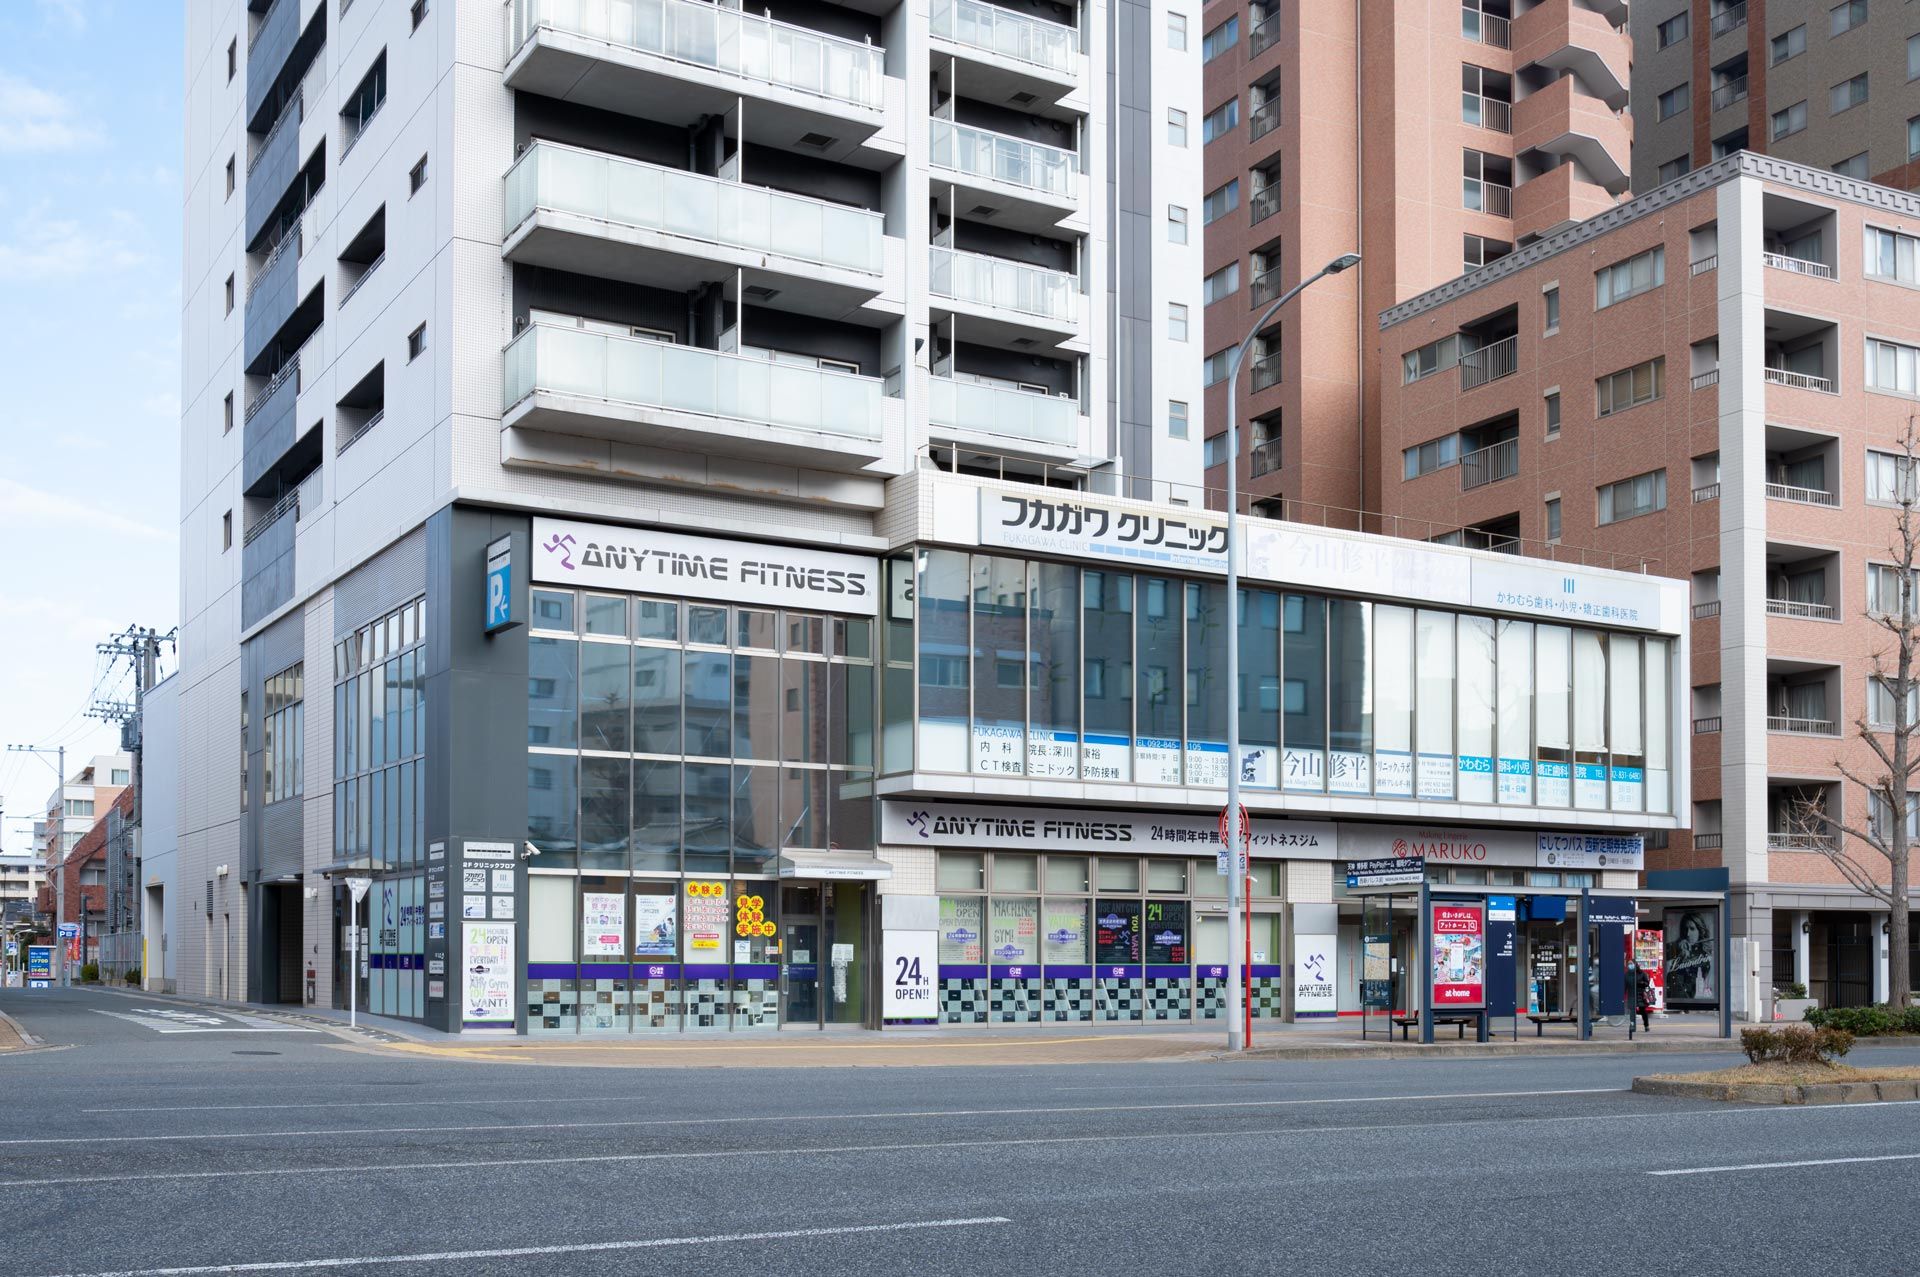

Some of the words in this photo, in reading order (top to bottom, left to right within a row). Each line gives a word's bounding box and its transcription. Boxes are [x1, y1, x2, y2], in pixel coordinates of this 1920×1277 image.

[1002, 496, 1109, 537] フカガワ
[1118, 513, 1228, 554] クリニック
[1003, 532, 1056, 549] FUKAGAWA
[1059, 541, 1088, 552] CLINIC
[581, 542, 728, 581] ANYTIME
[740, 560, 866, 596] FITNESS
[490, 574, 503, 624] P
[973, 726, 1023, 739] FUKAGAWA
[1083, 766, 1120, 779] 予防接種
[933, 816, 1035, 838] ANYTIME
[1043, 821, 1132, 842] FITNESS
[1411, 842, 1486, 860] MARUKO
[1540, 836, 1583, 850] にしてつバス
[1148, 904, 1162, 921] 24
[738, 923, 774, 935] 実施中
[1131, 915, 1139, 932] YOU
[486, 936, 508, 944] OPEN
[1131, 935, 1139, 960] WANT
[895, 956, 922, 985] 24
[923, 977, 929, 985] H
[895, 989, 929, 999] OPEN!!
